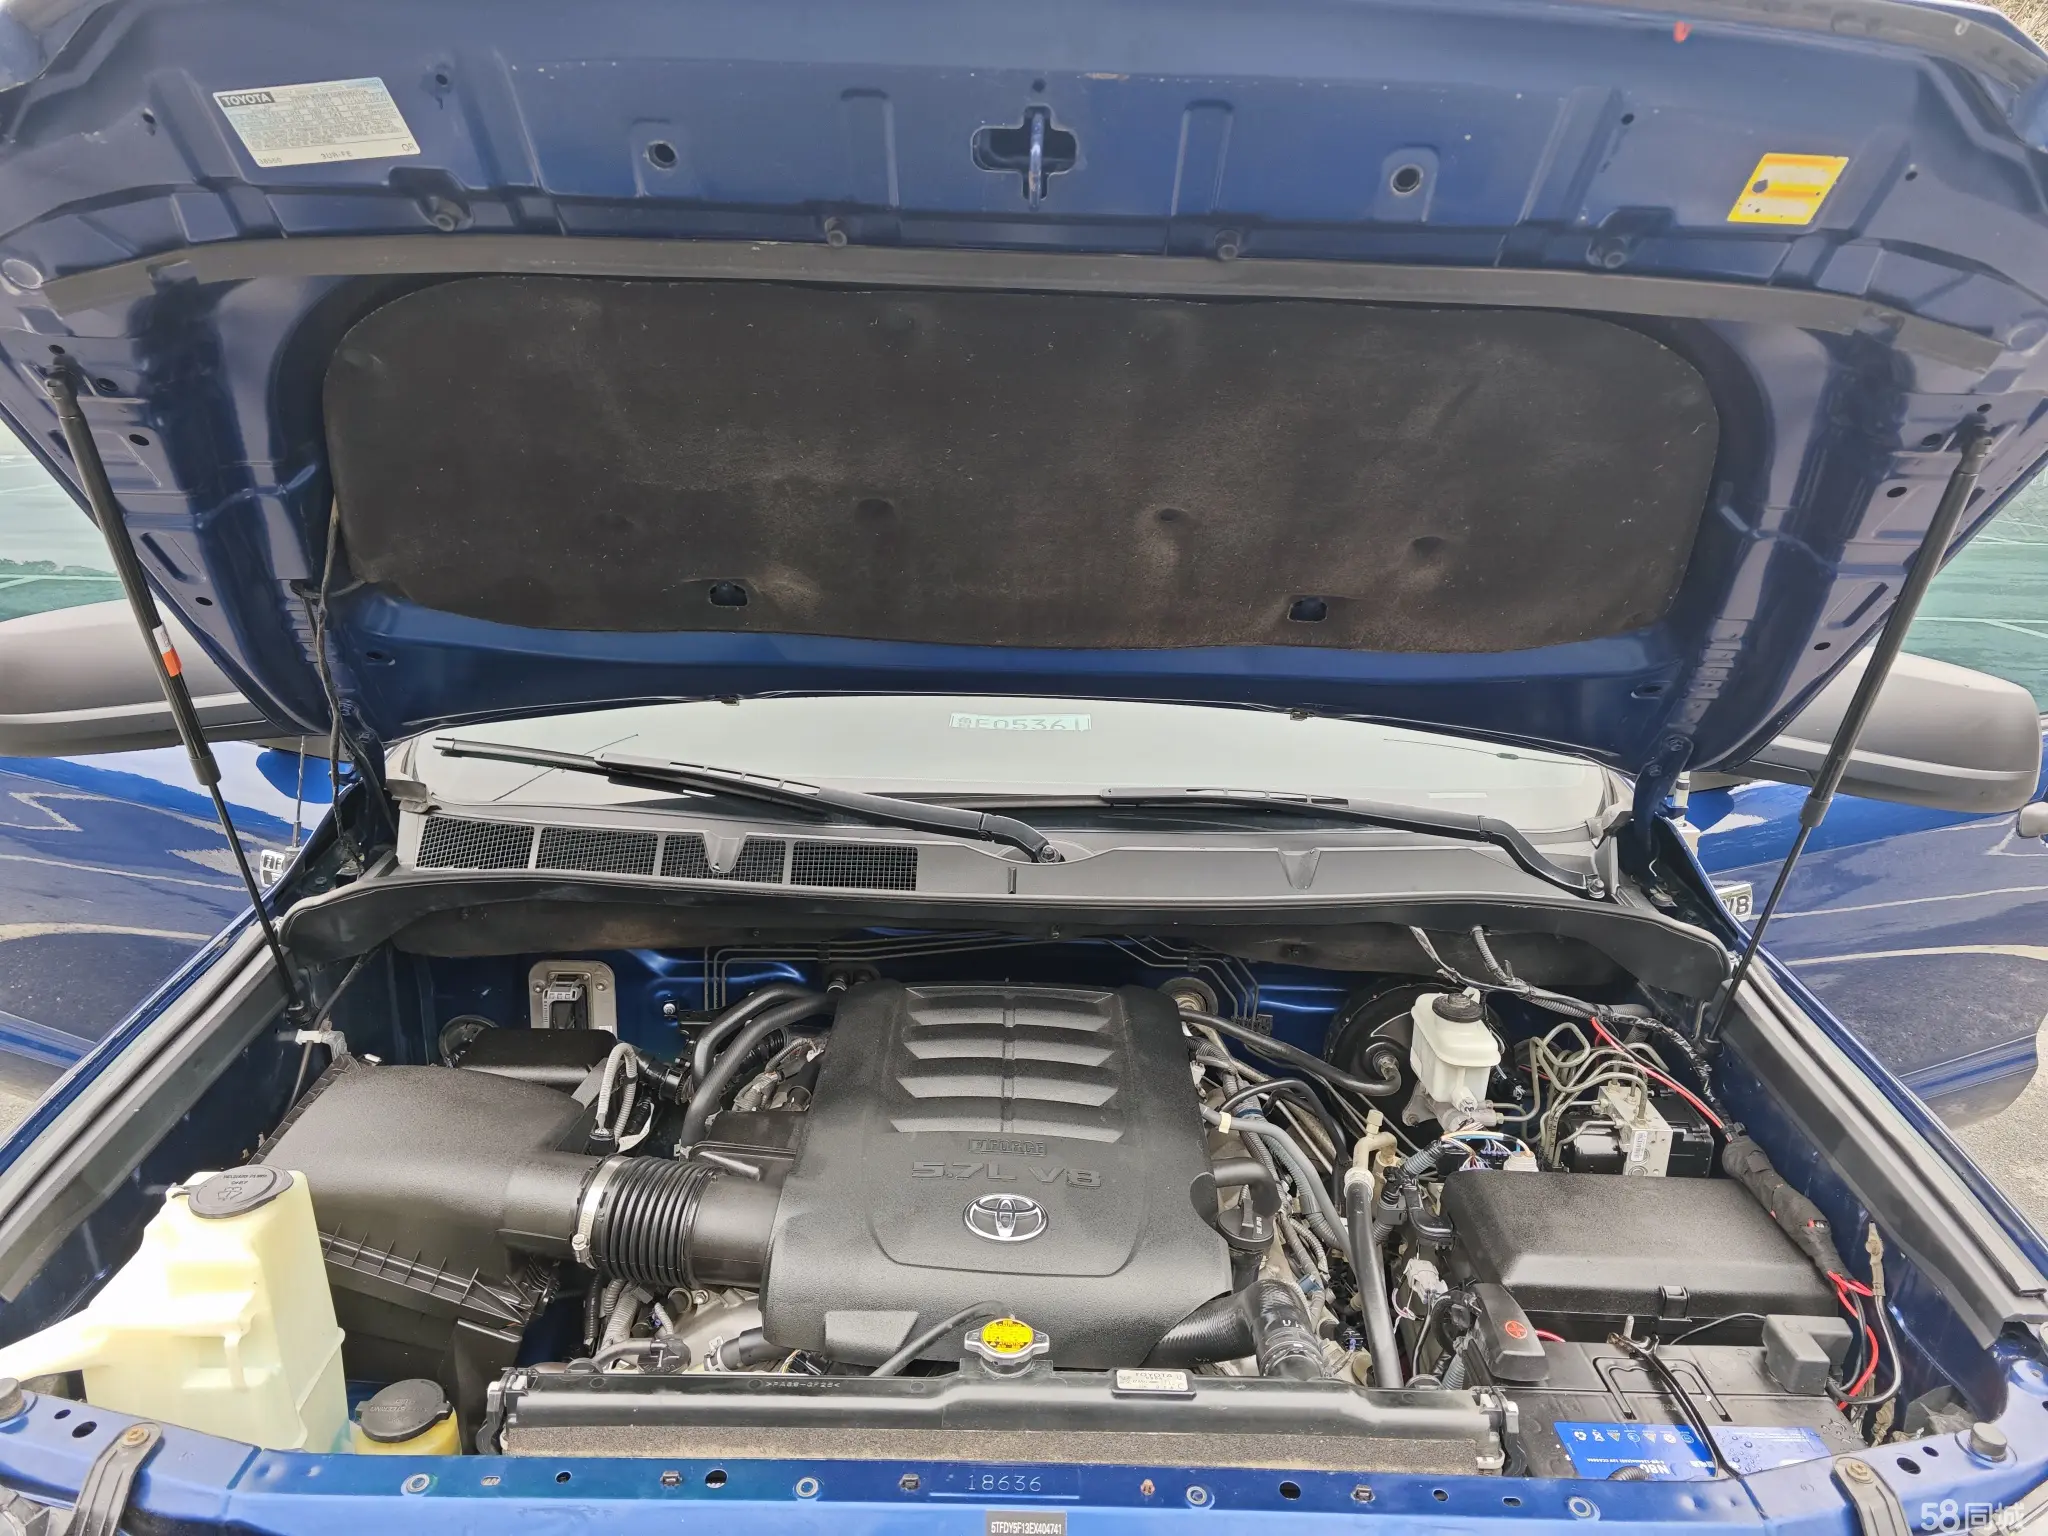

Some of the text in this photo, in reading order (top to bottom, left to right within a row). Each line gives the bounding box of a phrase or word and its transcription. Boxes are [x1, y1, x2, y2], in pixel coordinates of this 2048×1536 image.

[220, 93, 272, 106] TOYOTA
[912, 1161, 1101, 1188] 5.7L V8
[967, 1474, 1042, 1492] 18636
